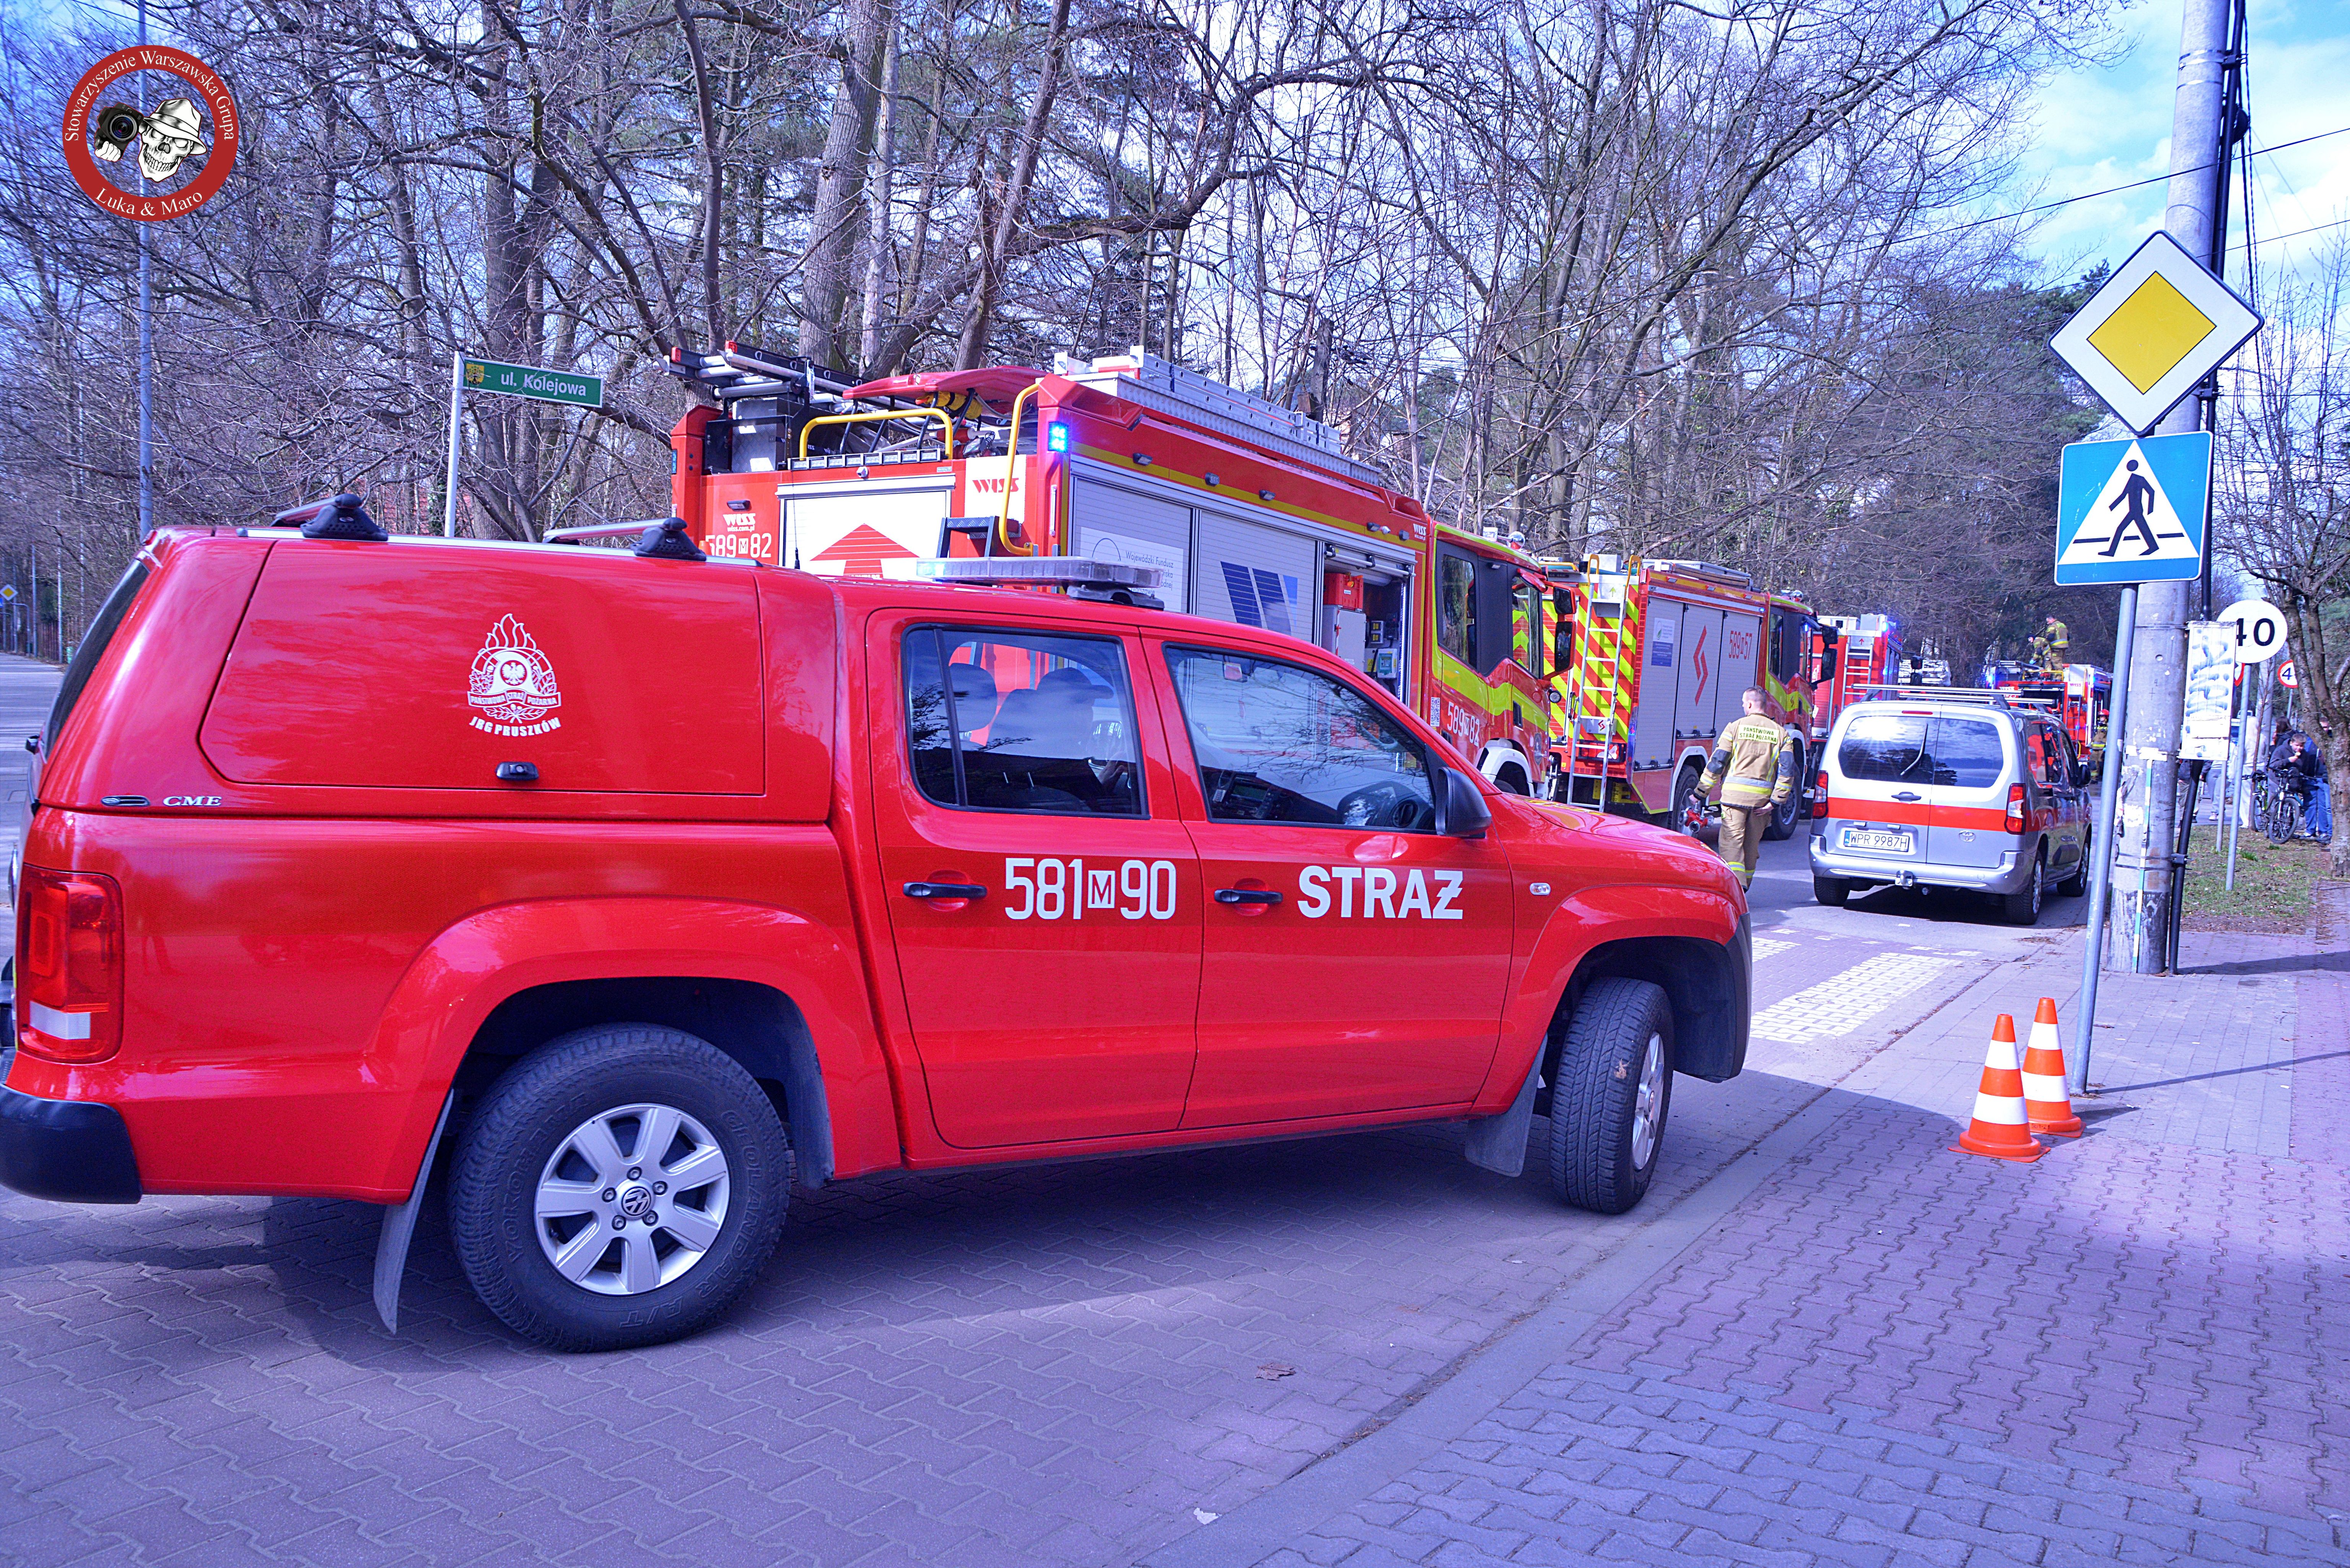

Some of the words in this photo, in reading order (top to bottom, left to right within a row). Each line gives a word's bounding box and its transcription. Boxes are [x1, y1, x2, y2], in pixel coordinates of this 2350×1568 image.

[501, 372, 517, 386] ul.
[524, 374, 586, 396] Kolejowa
[723, 513, 756, 525] WISS
[1413, 523, 1426, 536] WISS
[1156, 558, 1173, 568] Fundusz
[1160, 581, 1173, 590] odnej
[2282, 667, 2293, 680] 4
[469, 716, 493, 733] JRG
[494, 717, 561, 737] PRUSZKÓW
[163, 796, 222, 807] CME
[1851, 833, 1870, 844] WPR
[1874, 836, 1907, 848] 9987H
[619, 1296, 683, 1328] A/T
